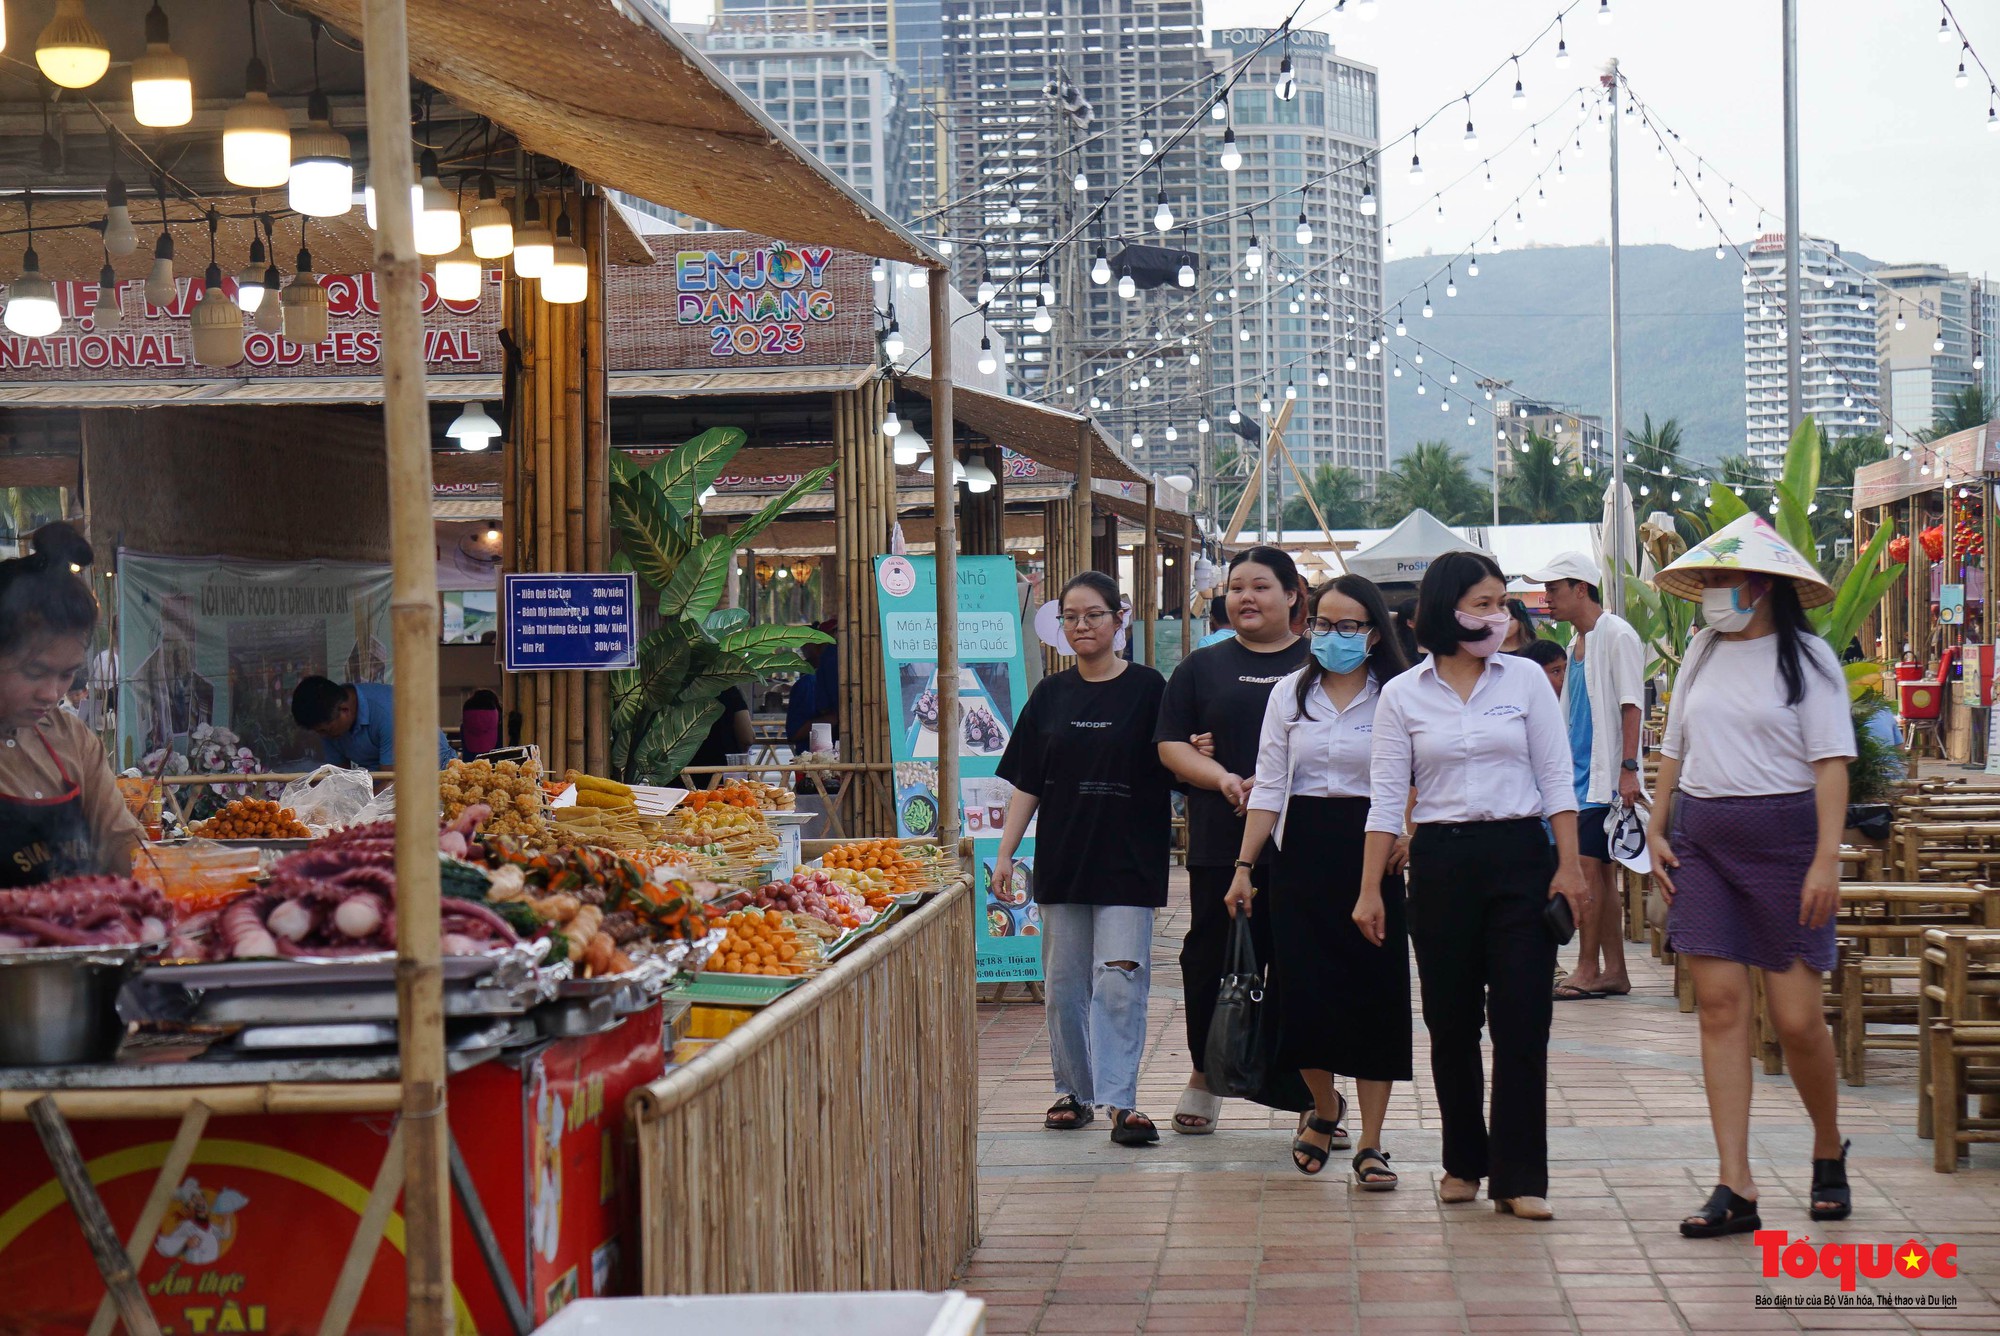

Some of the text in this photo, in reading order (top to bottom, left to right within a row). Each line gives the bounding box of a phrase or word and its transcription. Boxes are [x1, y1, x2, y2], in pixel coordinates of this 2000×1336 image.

[1222, 29, 1326, 48] FOUR OINTS
[676, 244, 833, 291] ENJOY
[678, 291, 835, 324] DANANG
[711, 324, 805, 356] 2023
[248, 586, 276, 616] FOOD
[288, 586, 316, 616] DRINK
[897, 619, 922, 631] Món
[982, 617, 1004, 631] Phố
[893, 638, 920, 651] Nhật
[923, 637, 938, 651] Bả
[980, 636, 1008, 651] Quốc
